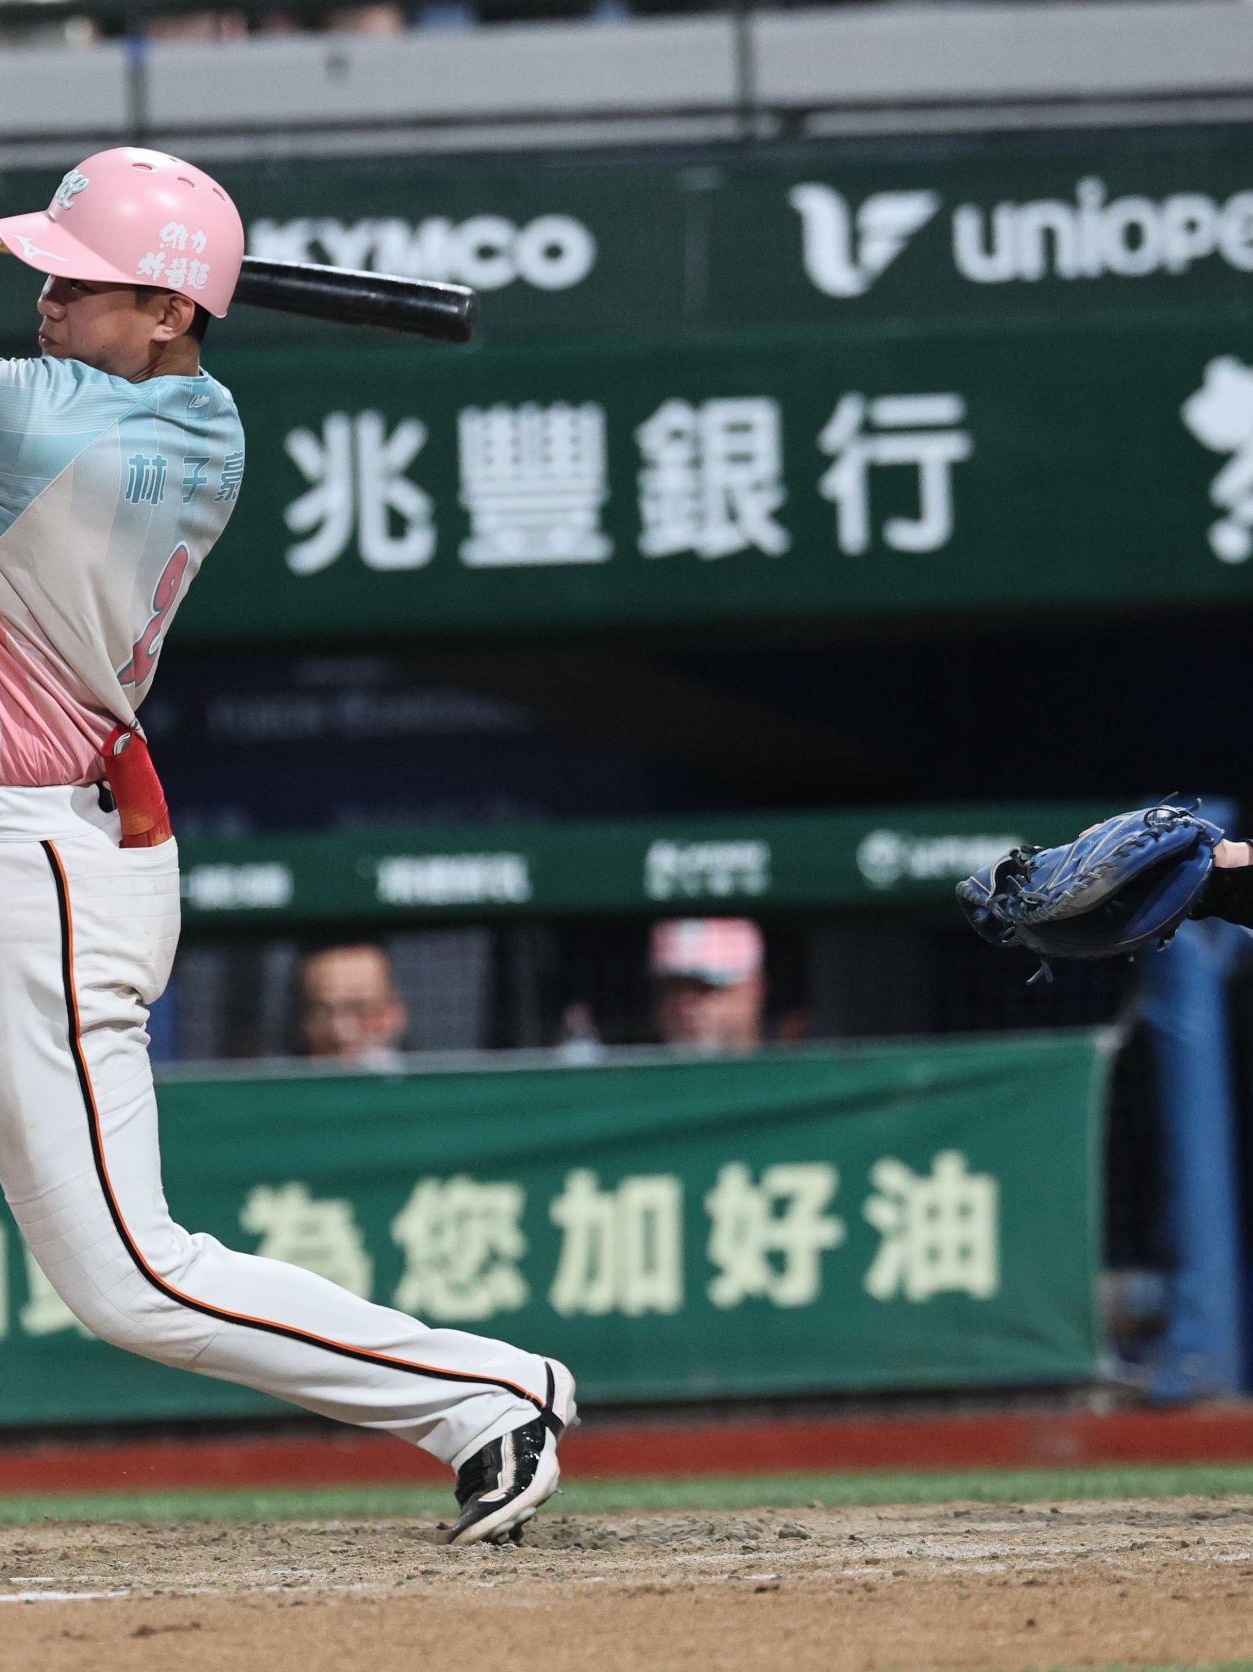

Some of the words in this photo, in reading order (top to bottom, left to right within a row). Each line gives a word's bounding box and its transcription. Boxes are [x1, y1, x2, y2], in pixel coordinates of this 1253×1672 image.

[249, 213, 596, 291] KYMCO
[284, 393, 975, 576] 兆豐銀行
[239, 1148, 1001, 1322] 為您加好油
